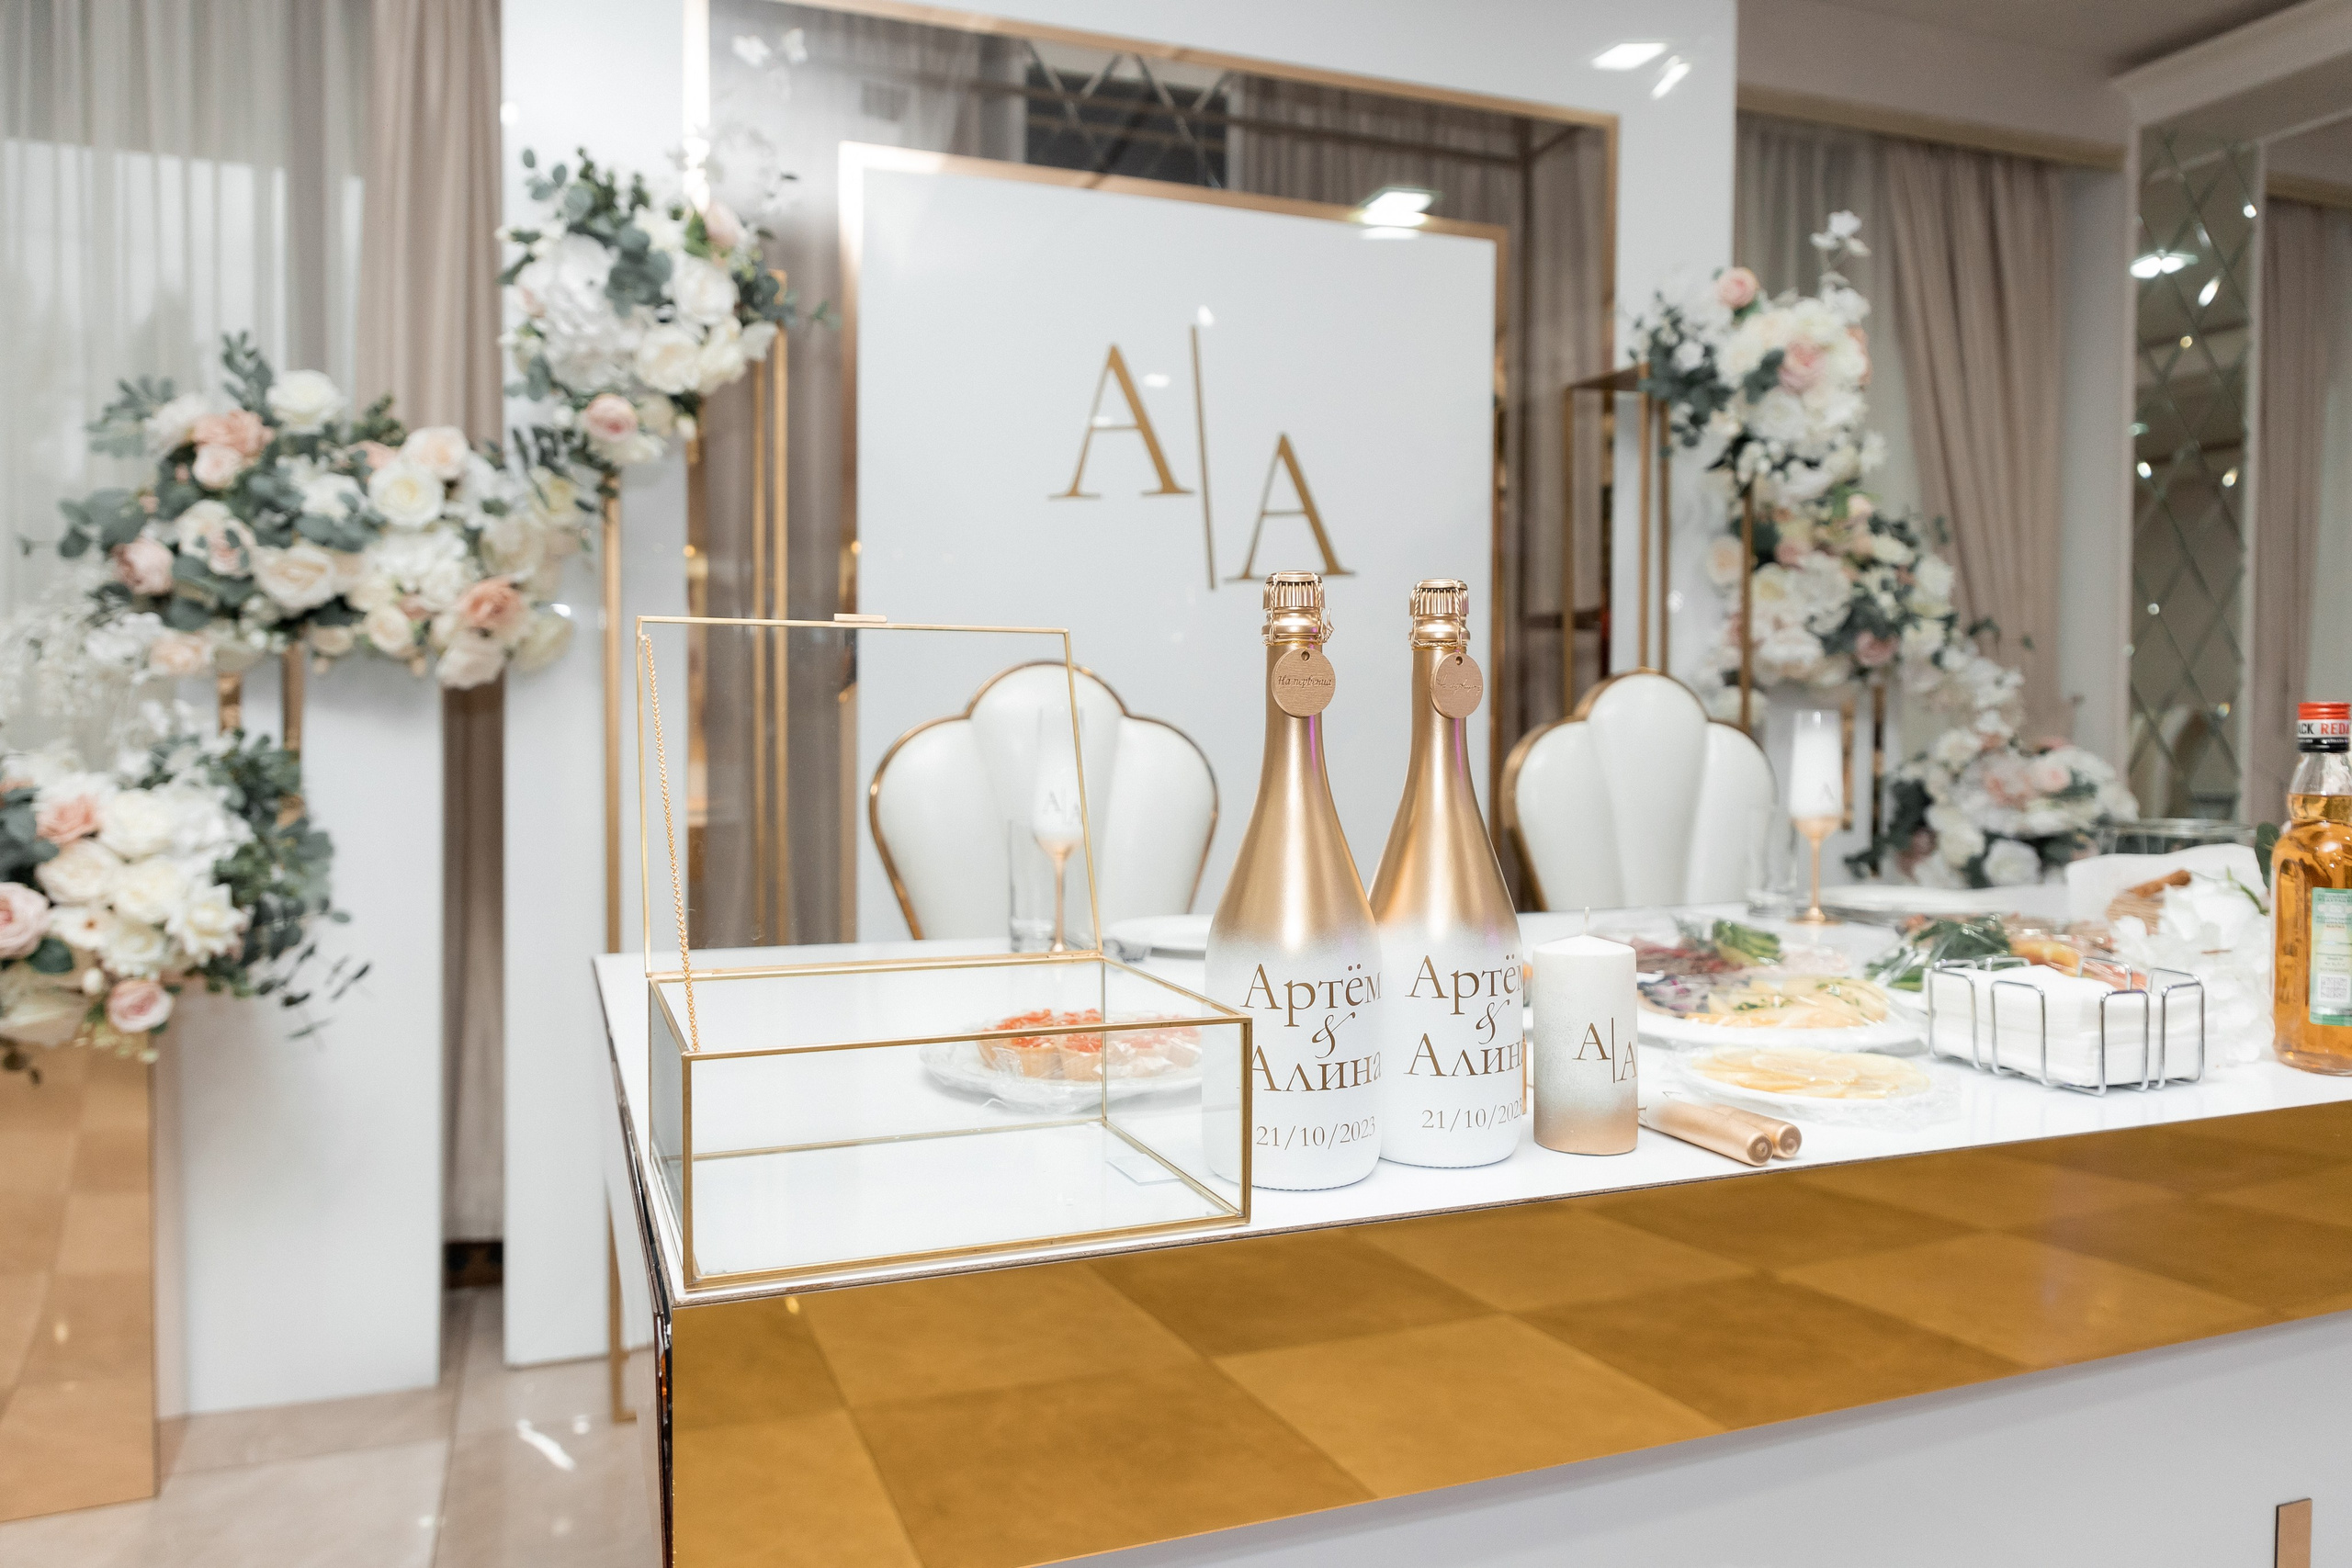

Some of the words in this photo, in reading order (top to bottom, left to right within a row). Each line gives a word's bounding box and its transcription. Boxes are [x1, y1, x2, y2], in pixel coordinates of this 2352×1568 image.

[1239, 963, 1382, 1028] Артём
[1311, 1011, 1356, 1059] &
[1475, 998, 1510, 1045] &
[1237, 1044, 1382, 1092] Алина
[1403, 1032, 1523, 1077] Алин
[1255, 1115, 1376, 1151] 21/10/2023
